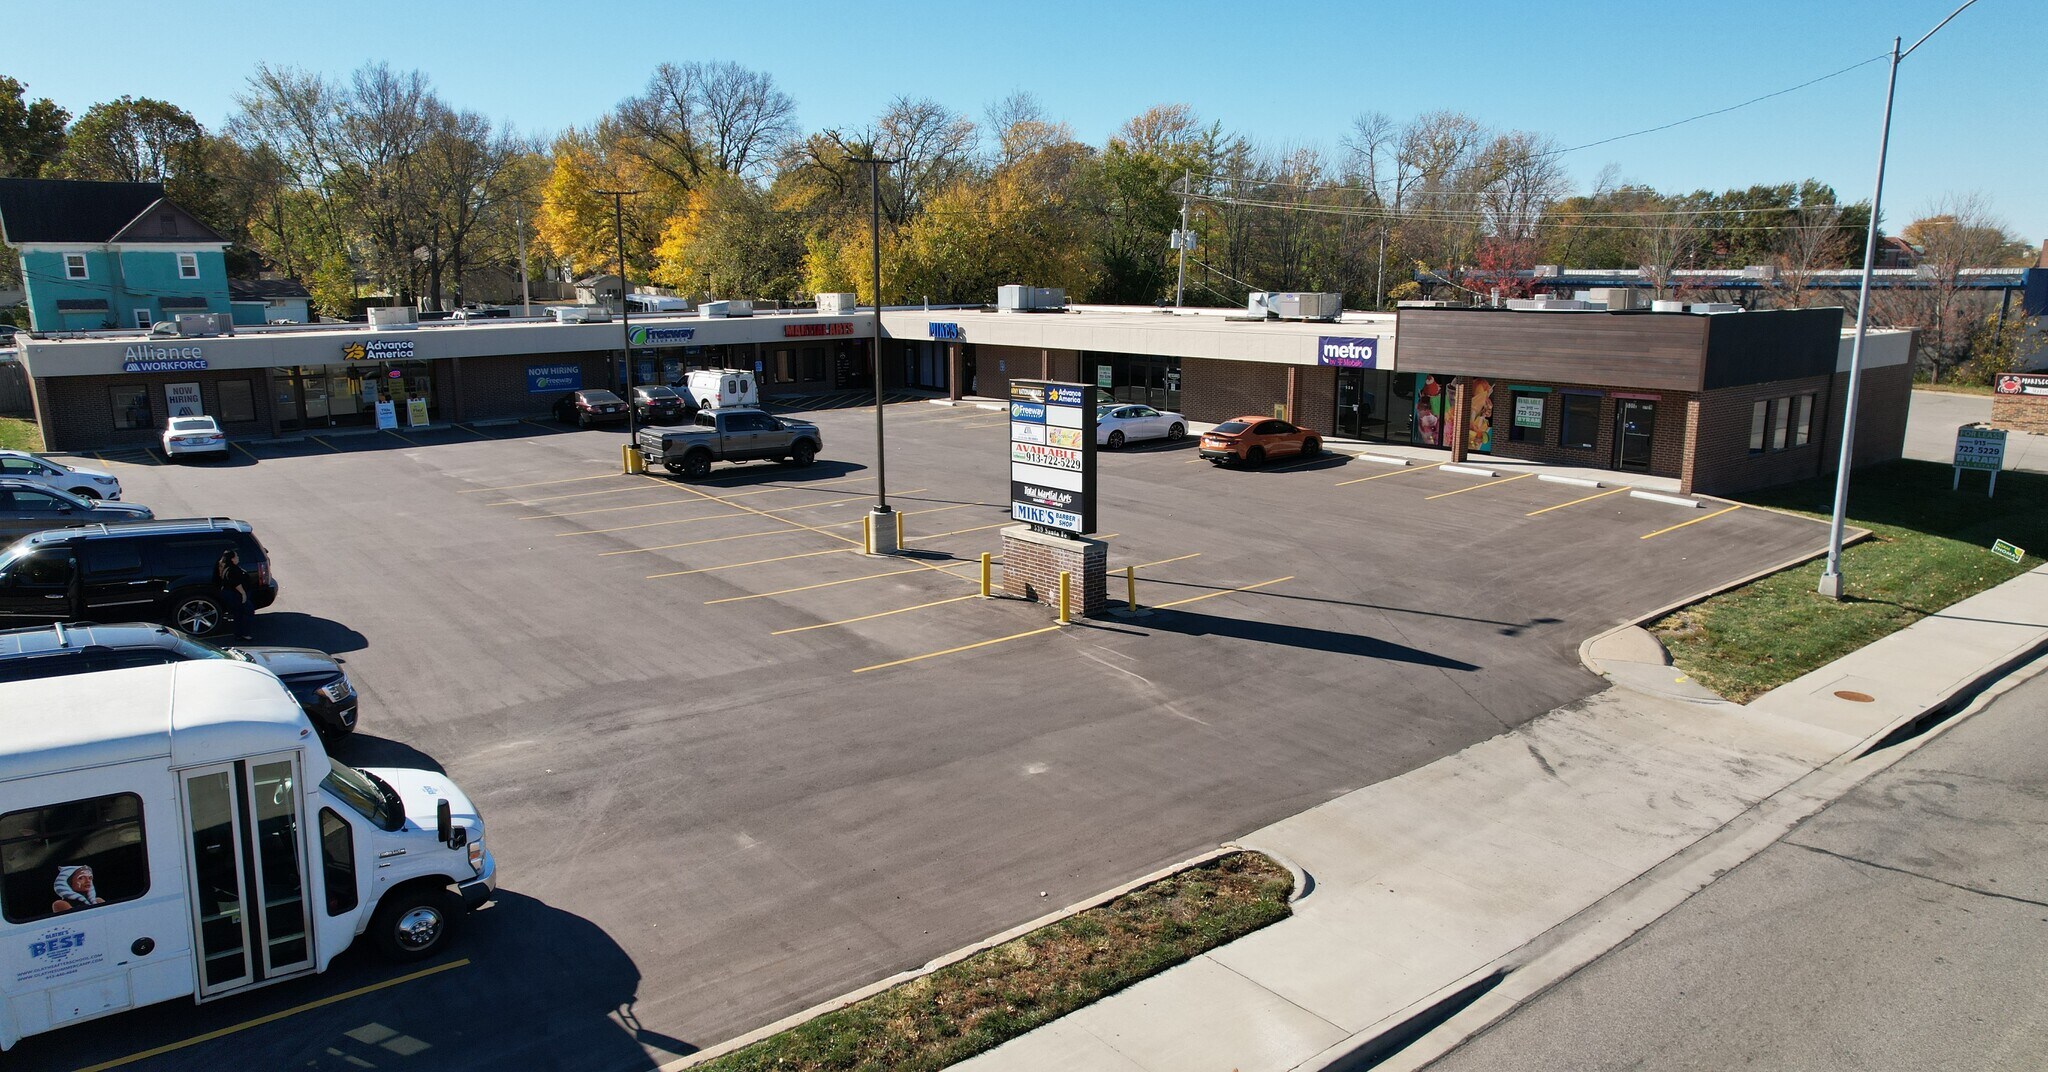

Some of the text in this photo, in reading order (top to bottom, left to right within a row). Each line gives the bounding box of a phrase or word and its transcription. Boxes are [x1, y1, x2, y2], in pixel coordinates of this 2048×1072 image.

[645, 327, 695, 340] Freeway
[785, 322, 854, 337] MARTIAL ARTS
[366, 340, 414, 350] Advance
[1323, 342, 1372, 360] metro
[125, 345, 202, 361] Alliance
[367, 350, 414, 359] America
[141, 360, 207, 371] WORKFORCE
[550, 366, 578, 374] HIRING
[172, 387, 192, 395] NOW
[1058, 388, 1082, 397] Advance
[169, 394, 199, 404] HIRING
[1020, 405, 1044, 417] Freeway
[1016, 444, 1076, 460] AVAILABLE
[1026, 452, 1080, 469] 913-722-5229
[1024, 486, 1037, 498] Total
[1038, 488, 1058, 501] Martial
[1058, 492, 1072, 504] Arts
[1018, 506, 1054, 524] MIKE'S
[1056, 512, 1076, 522] BARBER
[30, 932, 85, 958] BEST
